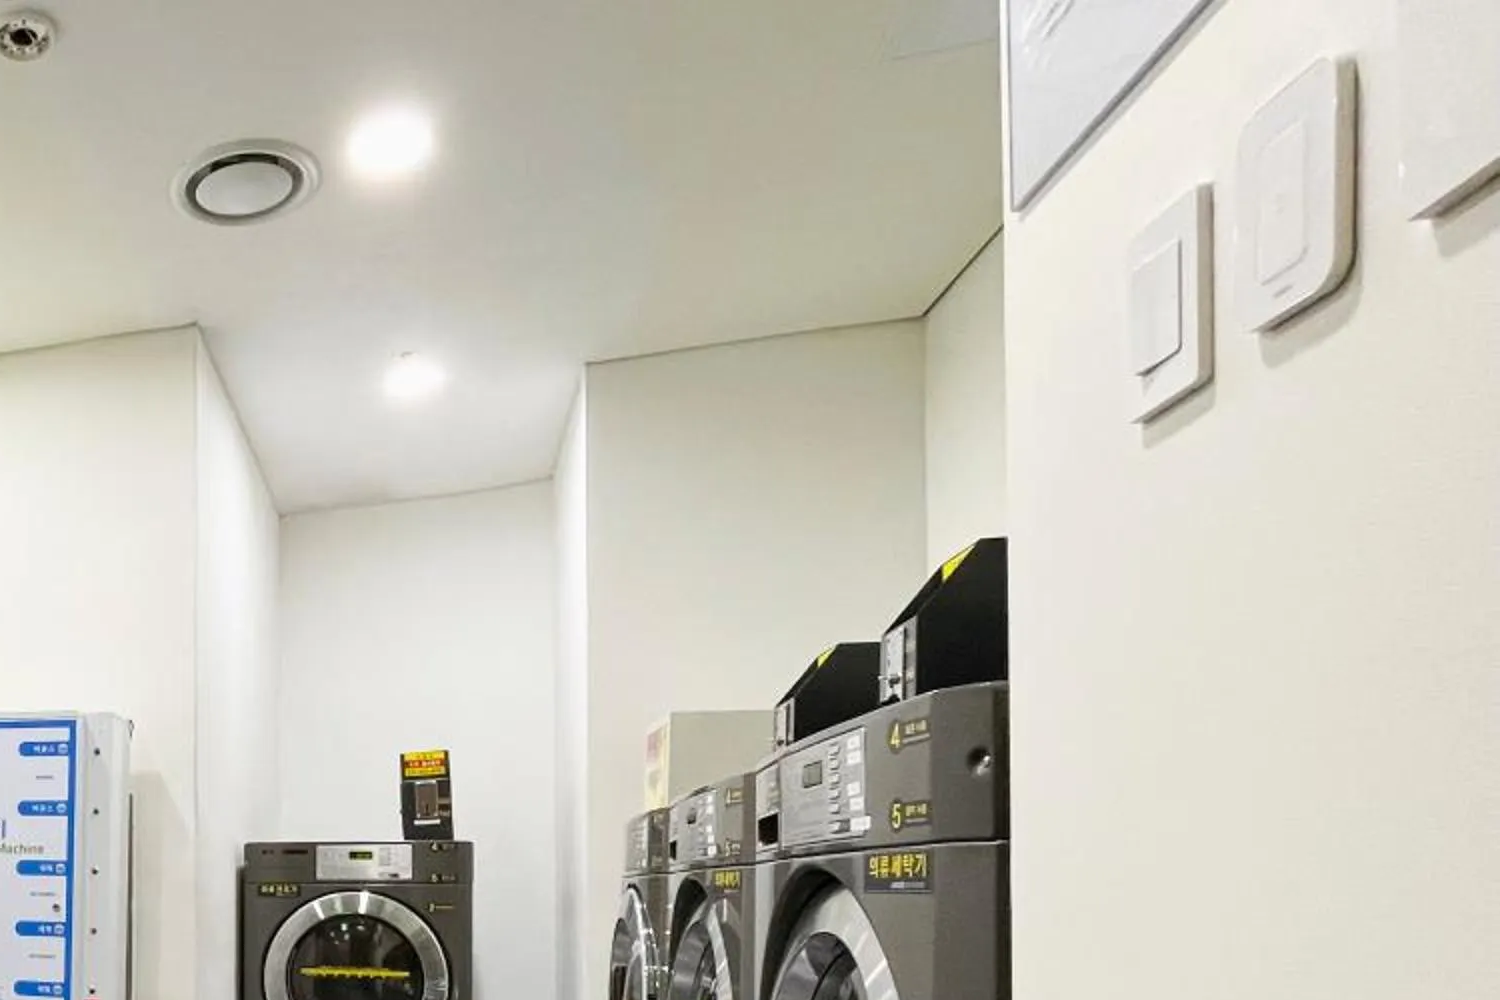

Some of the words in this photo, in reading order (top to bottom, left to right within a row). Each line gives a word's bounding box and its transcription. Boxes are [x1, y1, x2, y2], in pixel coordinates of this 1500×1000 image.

[890, 722, 901, 749] 4
[891, 803, 901, 829] 5
[869, 852, 928, 878] 의류세탁기
